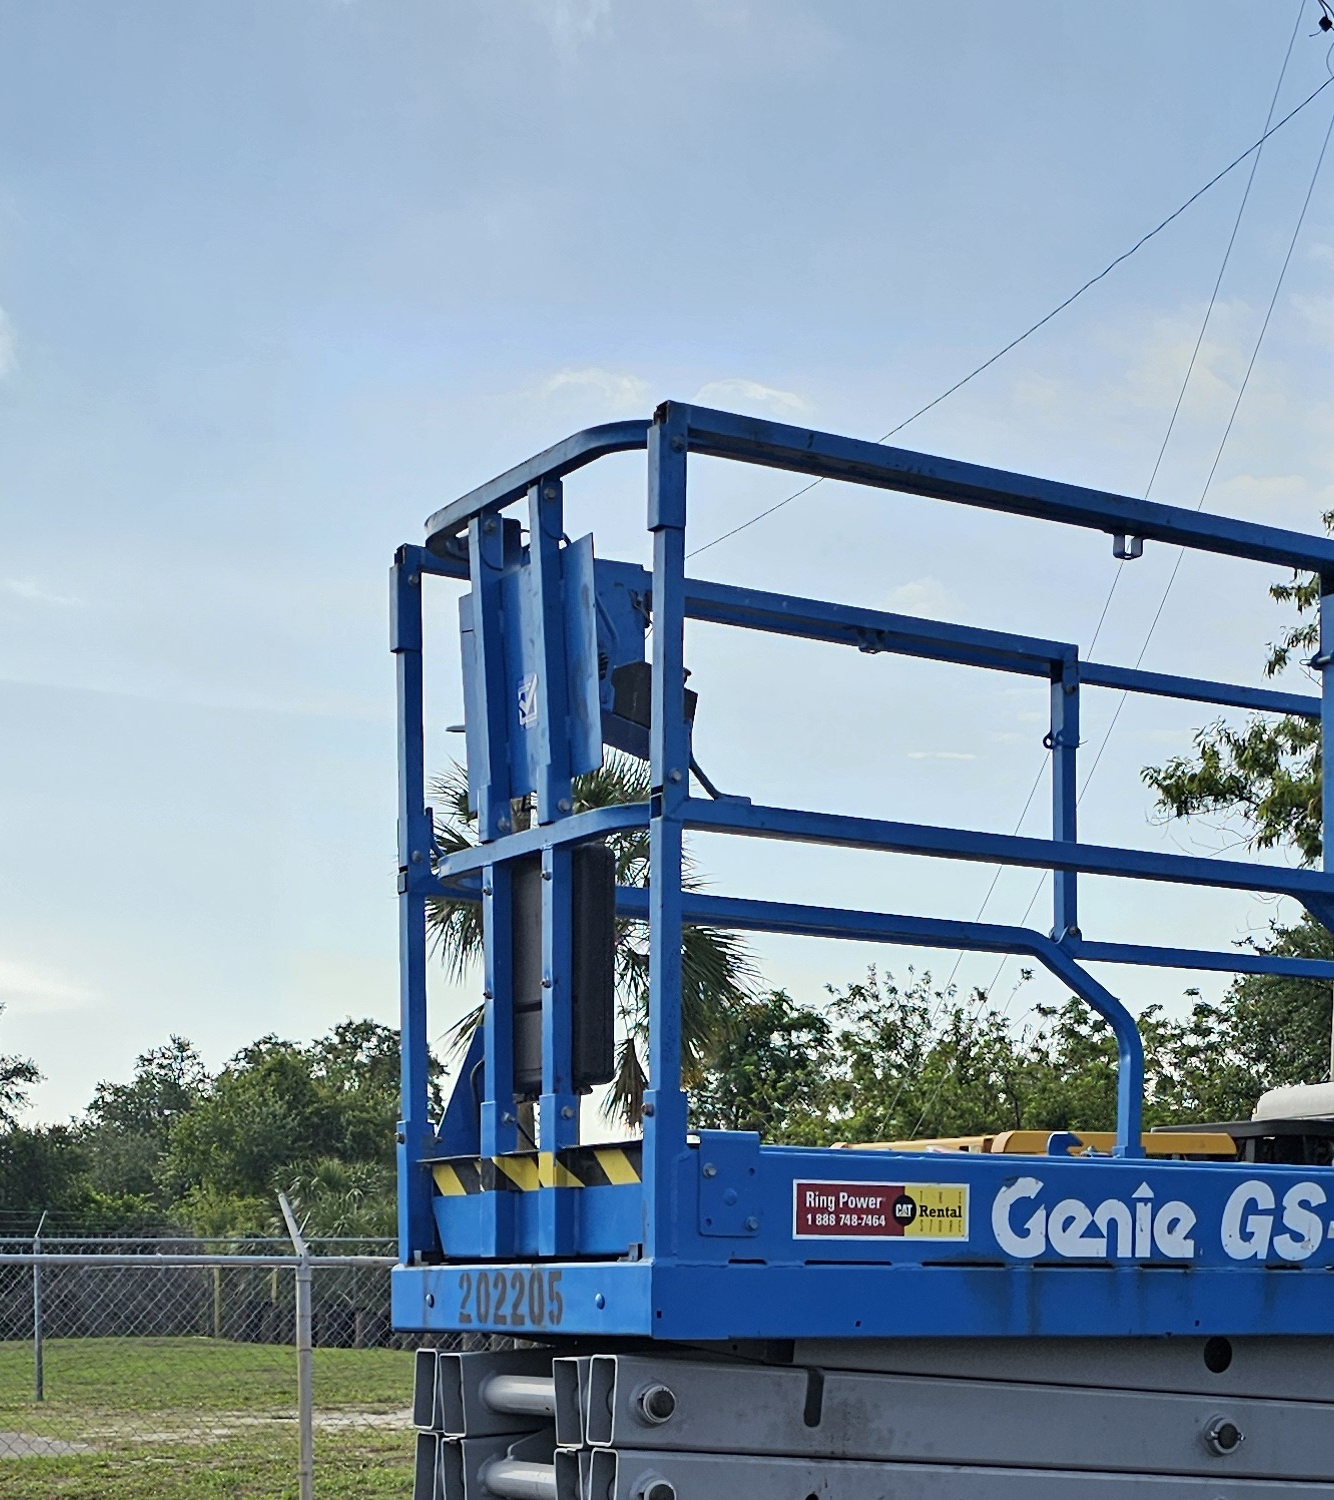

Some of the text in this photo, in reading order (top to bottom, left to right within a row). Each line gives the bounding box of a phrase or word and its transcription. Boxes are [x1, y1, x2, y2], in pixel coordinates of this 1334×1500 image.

[805, 1190, 883, 1212] Ring Power
[895, 1203, 914, 1218] CAT
[918, 1204, 963, 1219] Rental
[991, 1176, 1196, 1259] Genie
[806, 1213, 887, 1228] 1 888 748-7464
[458, 1270, 563, 1326] 202205
